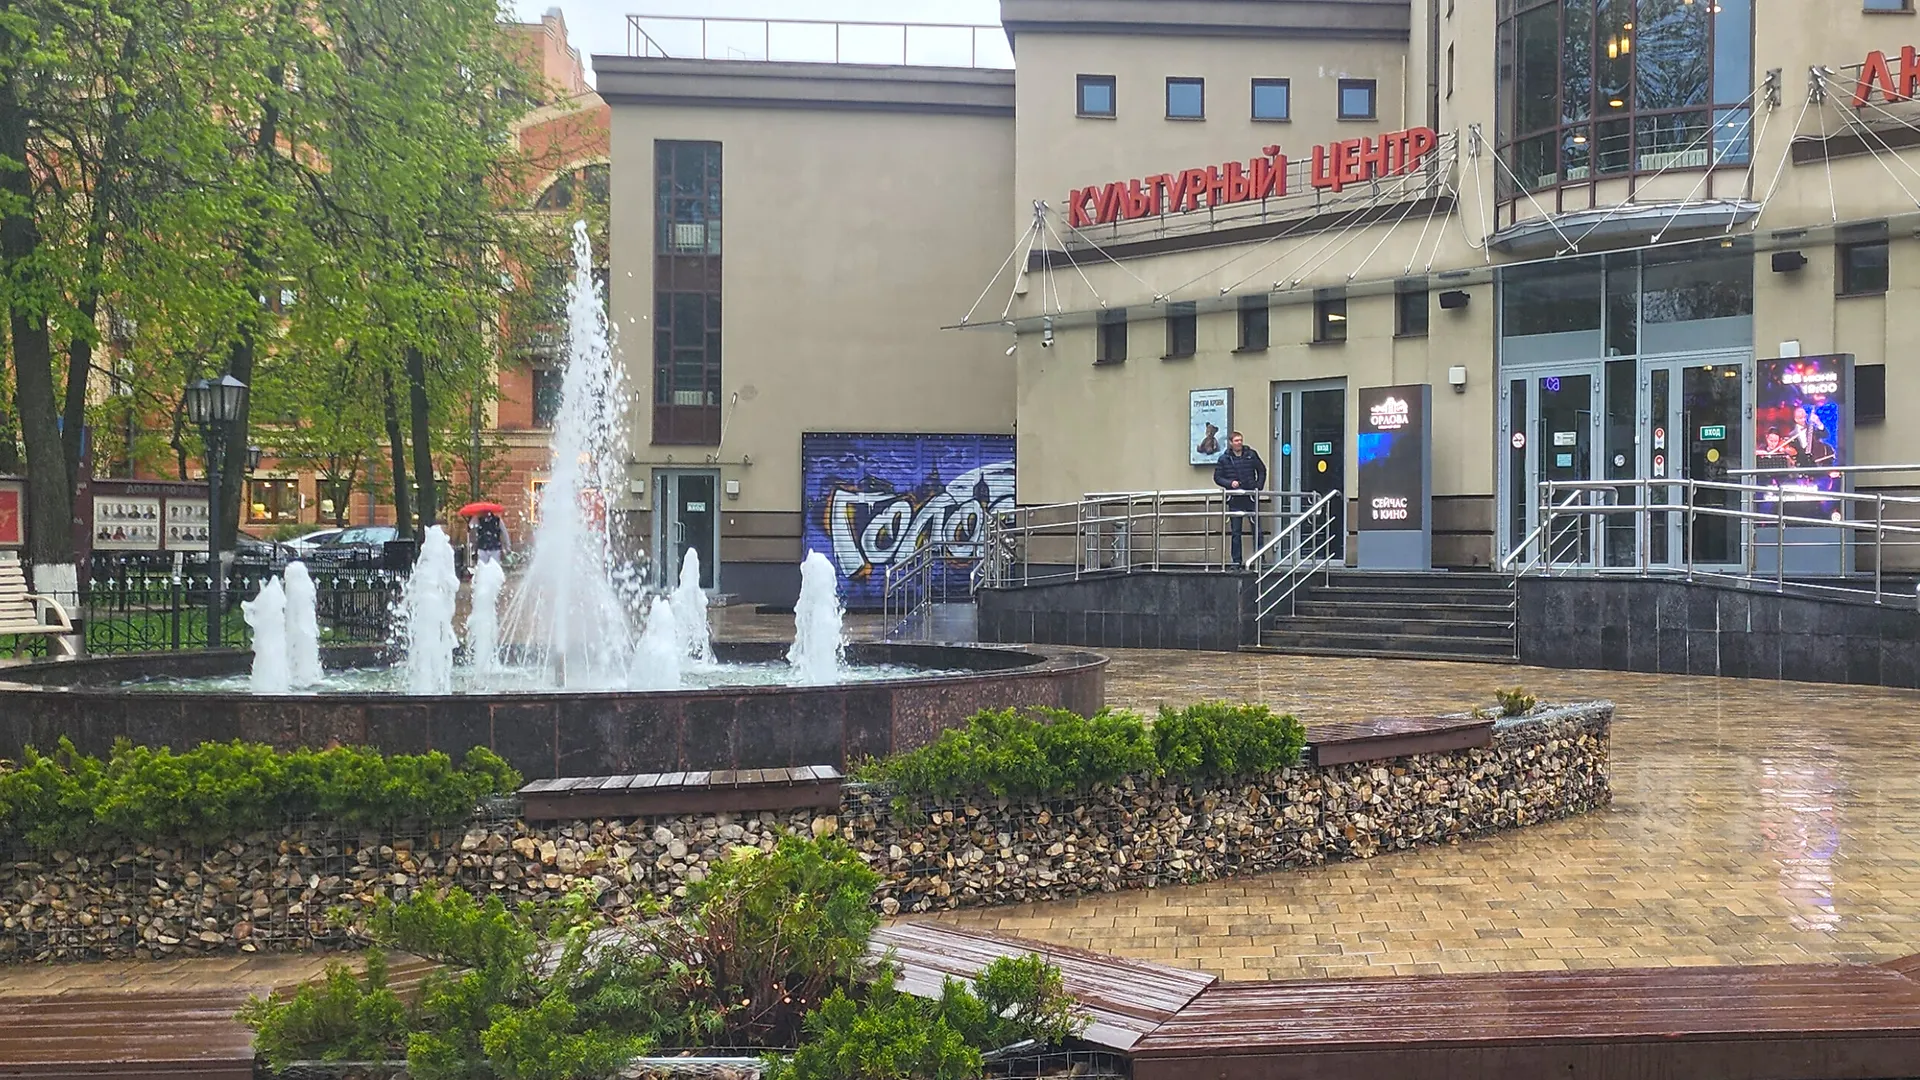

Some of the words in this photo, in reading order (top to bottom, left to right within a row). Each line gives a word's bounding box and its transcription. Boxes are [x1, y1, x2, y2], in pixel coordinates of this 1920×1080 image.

[1069, 145, 1288, 227] КУЛЬТУРНЫЙ
[1311, 127, 1437, 193] ЦЕНТР
[1370, 414, 1409, 425] ОРЛОВА
[1704, 428, 1721, 437] ВХОД
[1372, 496, 1408, 508] СЕЙЧАС
[1372, 509, 1379, 519] В
[1380, 509, 1408, 519] КИНО
